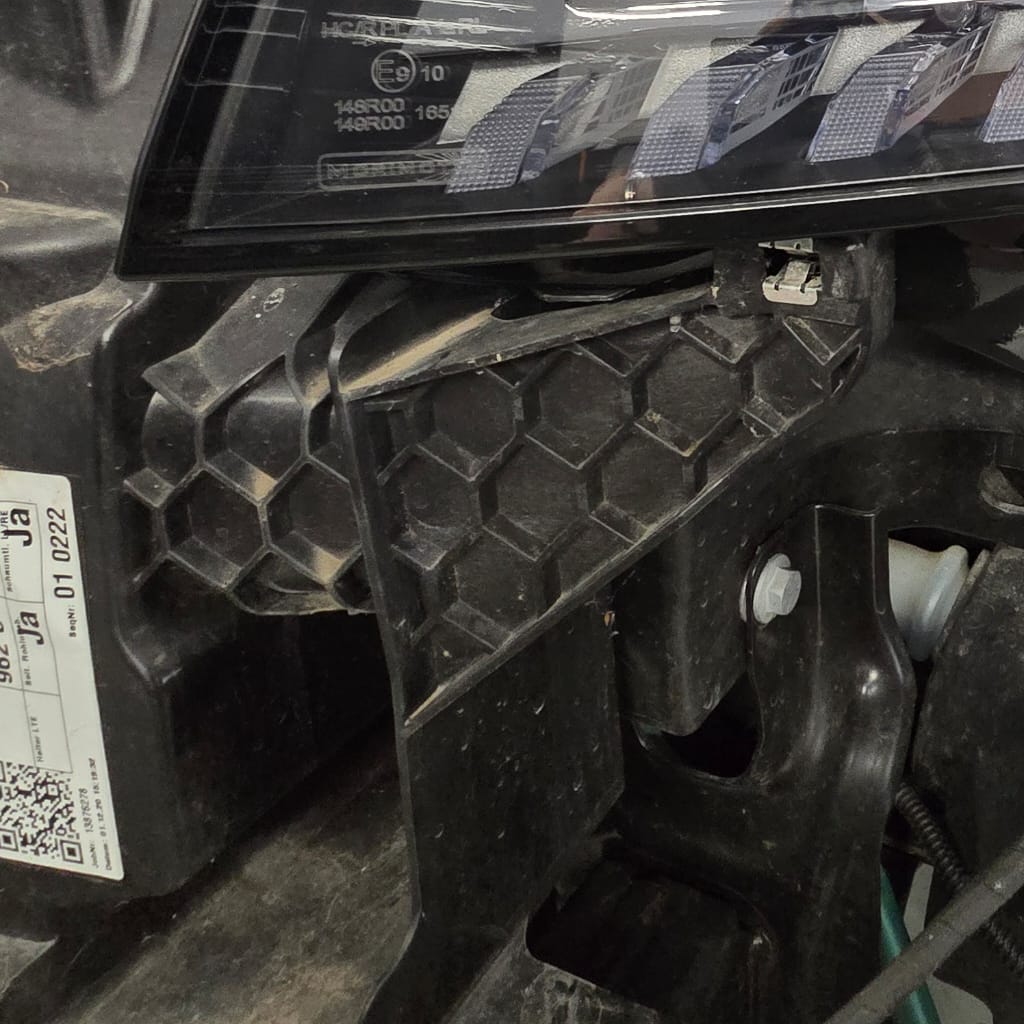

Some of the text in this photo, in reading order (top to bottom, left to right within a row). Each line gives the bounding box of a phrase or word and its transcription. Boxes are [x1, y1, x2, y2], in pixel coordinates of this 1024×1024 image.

[420, 64, 445, 82] 10
[3, 508, 33, 547] Ja
[46, 507, 71, 562] 0222
[52, 574, 75, 598] 01
[17, 611, 44, 645] Ja
